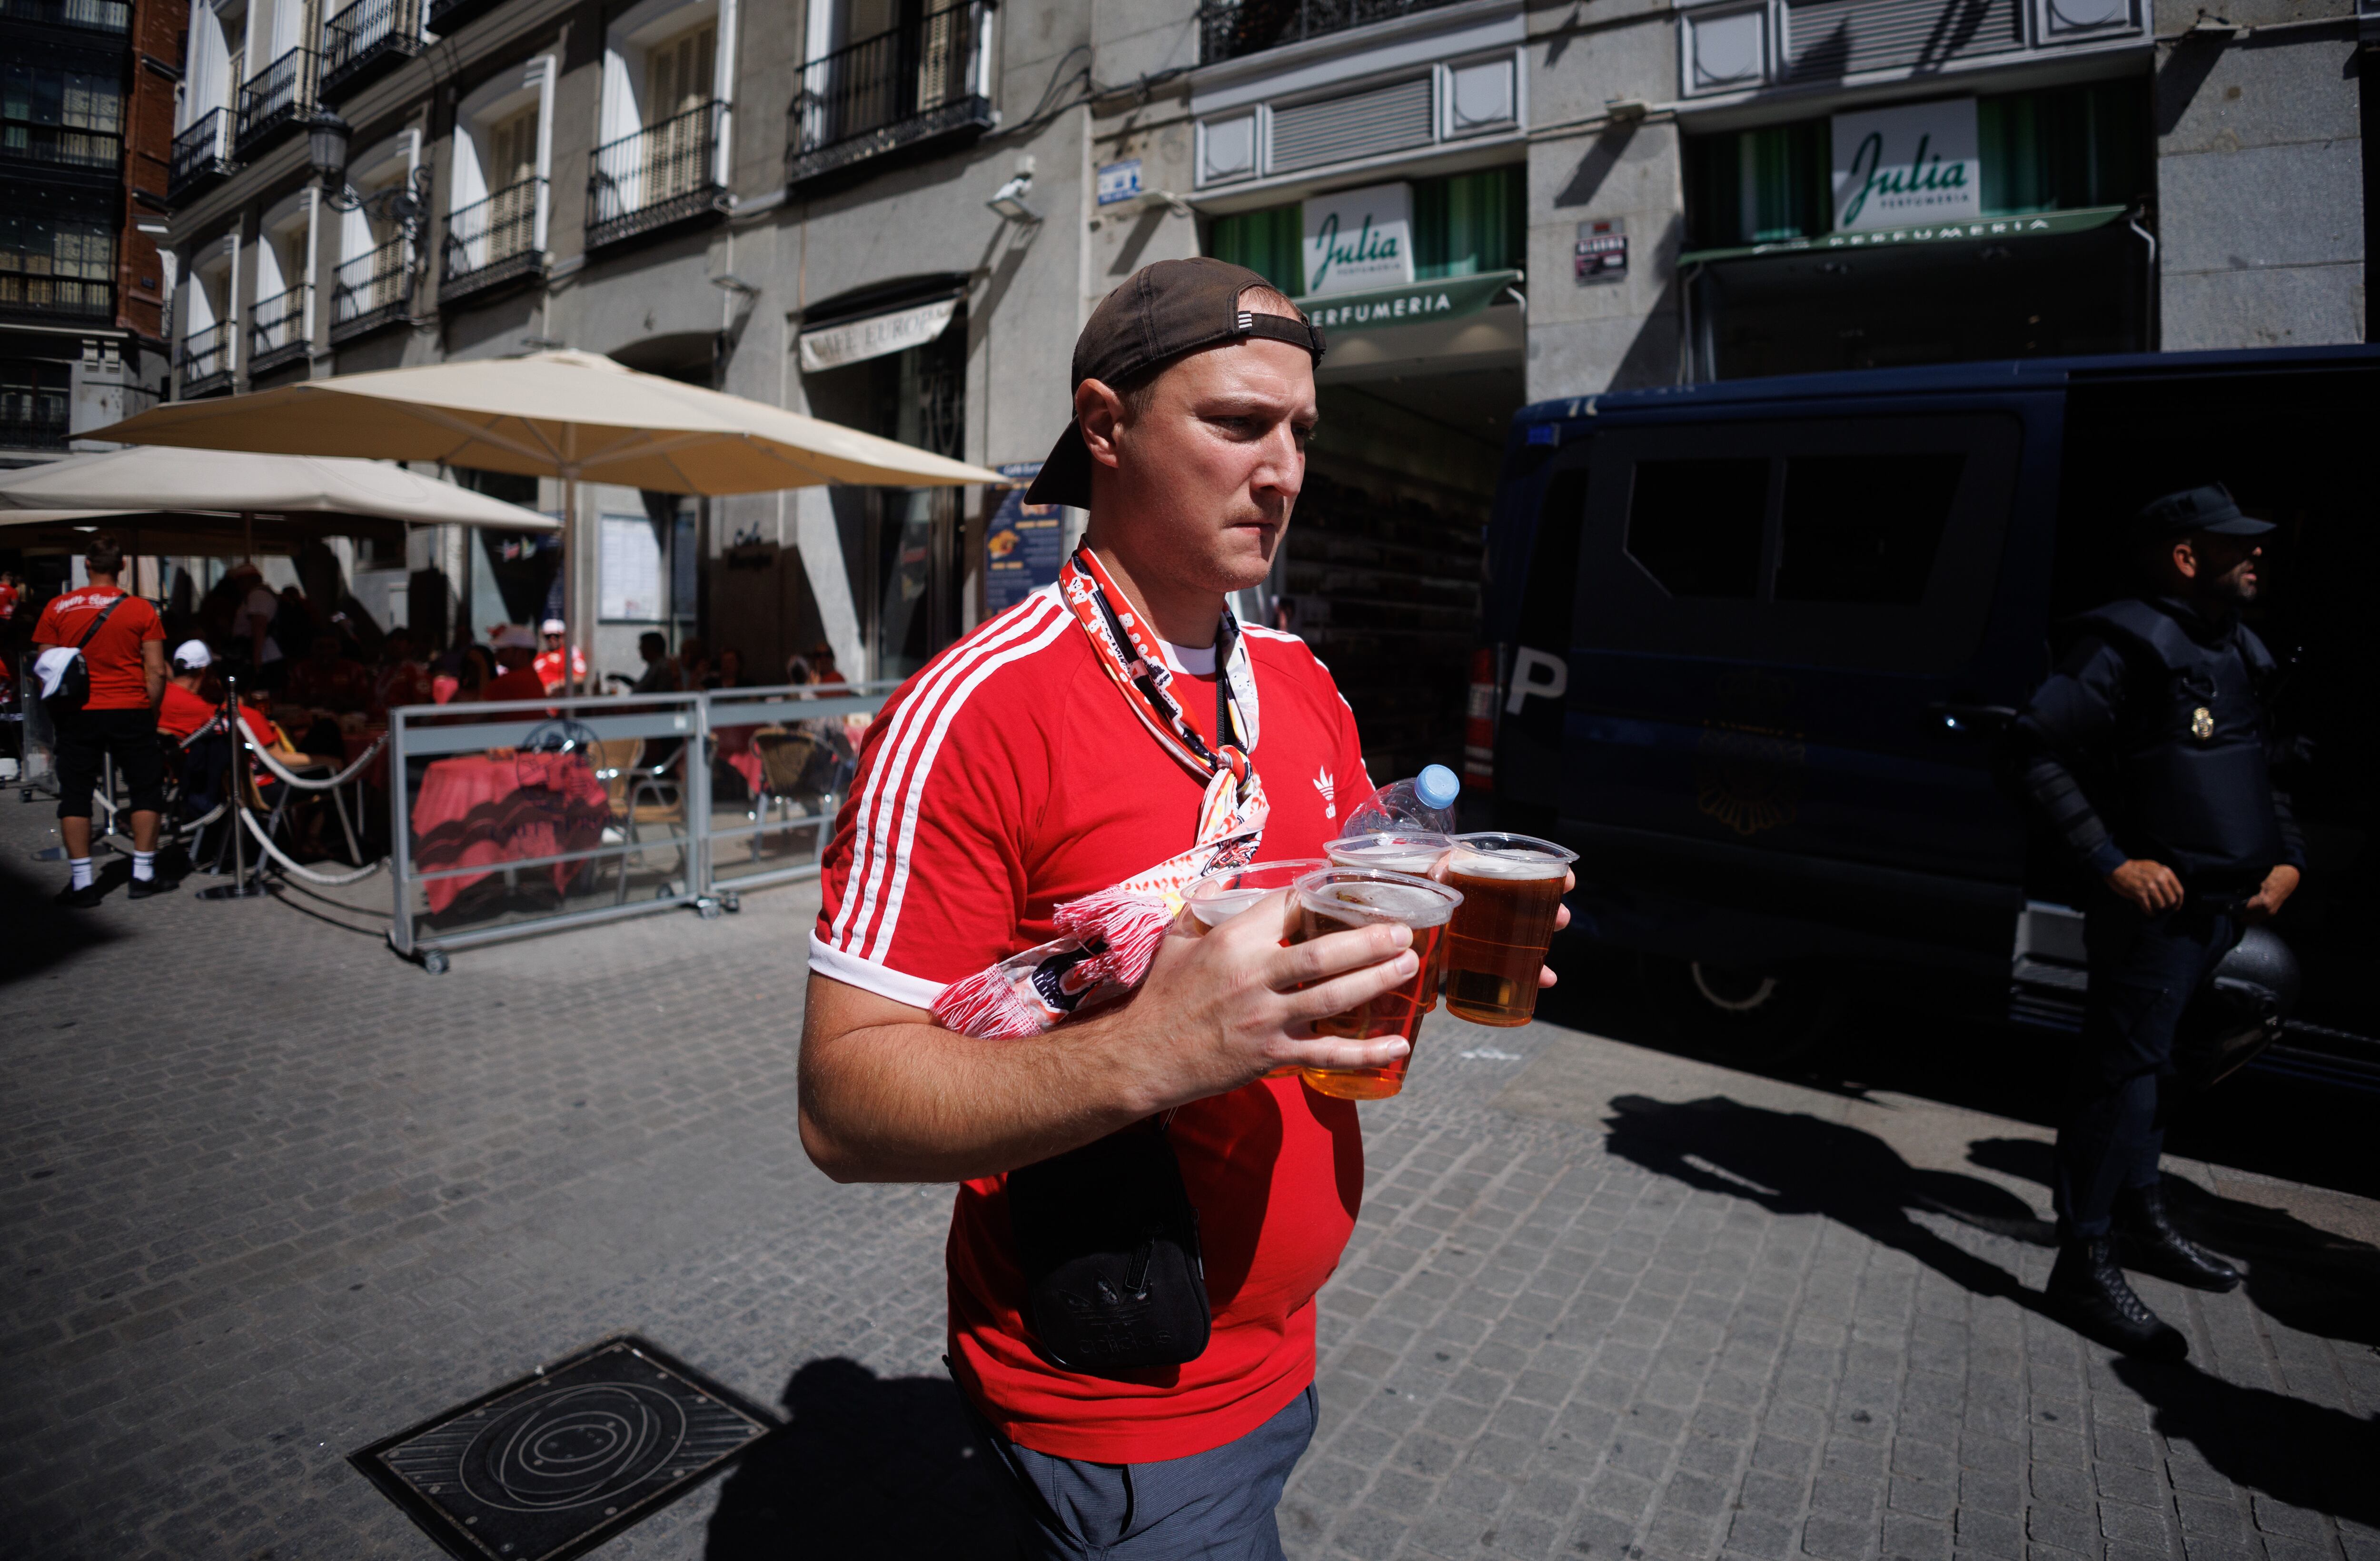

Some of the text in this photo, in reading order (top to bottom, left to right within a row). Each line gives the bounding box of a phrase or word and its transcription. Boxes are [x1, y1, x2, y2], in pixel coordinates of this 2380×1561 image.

[1843, 131, 1968, 227] Julia
[1829, 218, 2049, 247] PERFUMERIA
[1311, 212, 1399, 291] Julia
[1311, 293, 1451, 327] ERFUMERIA
[1078, 1330, 1173, 1355] adidas
